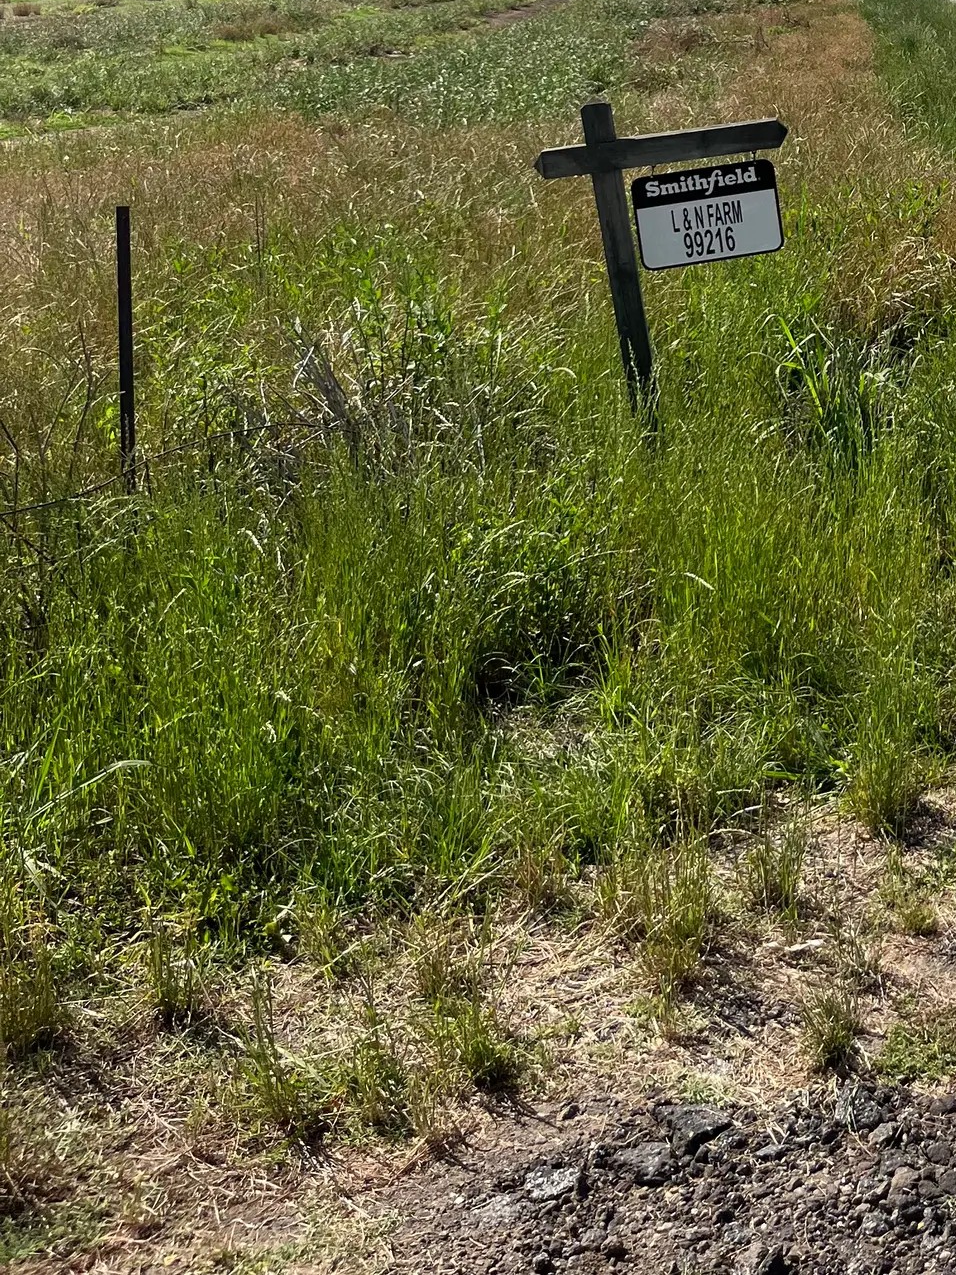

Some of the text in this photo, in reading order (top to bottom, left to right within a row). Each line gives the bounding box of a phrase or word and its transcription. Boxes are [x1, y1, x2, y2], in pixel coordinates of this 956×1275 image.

[645, 166, 758, 198] Smithfield
[671, 200, 743, 233] L & N FARM
[683, 226, 736, 258] 99216
